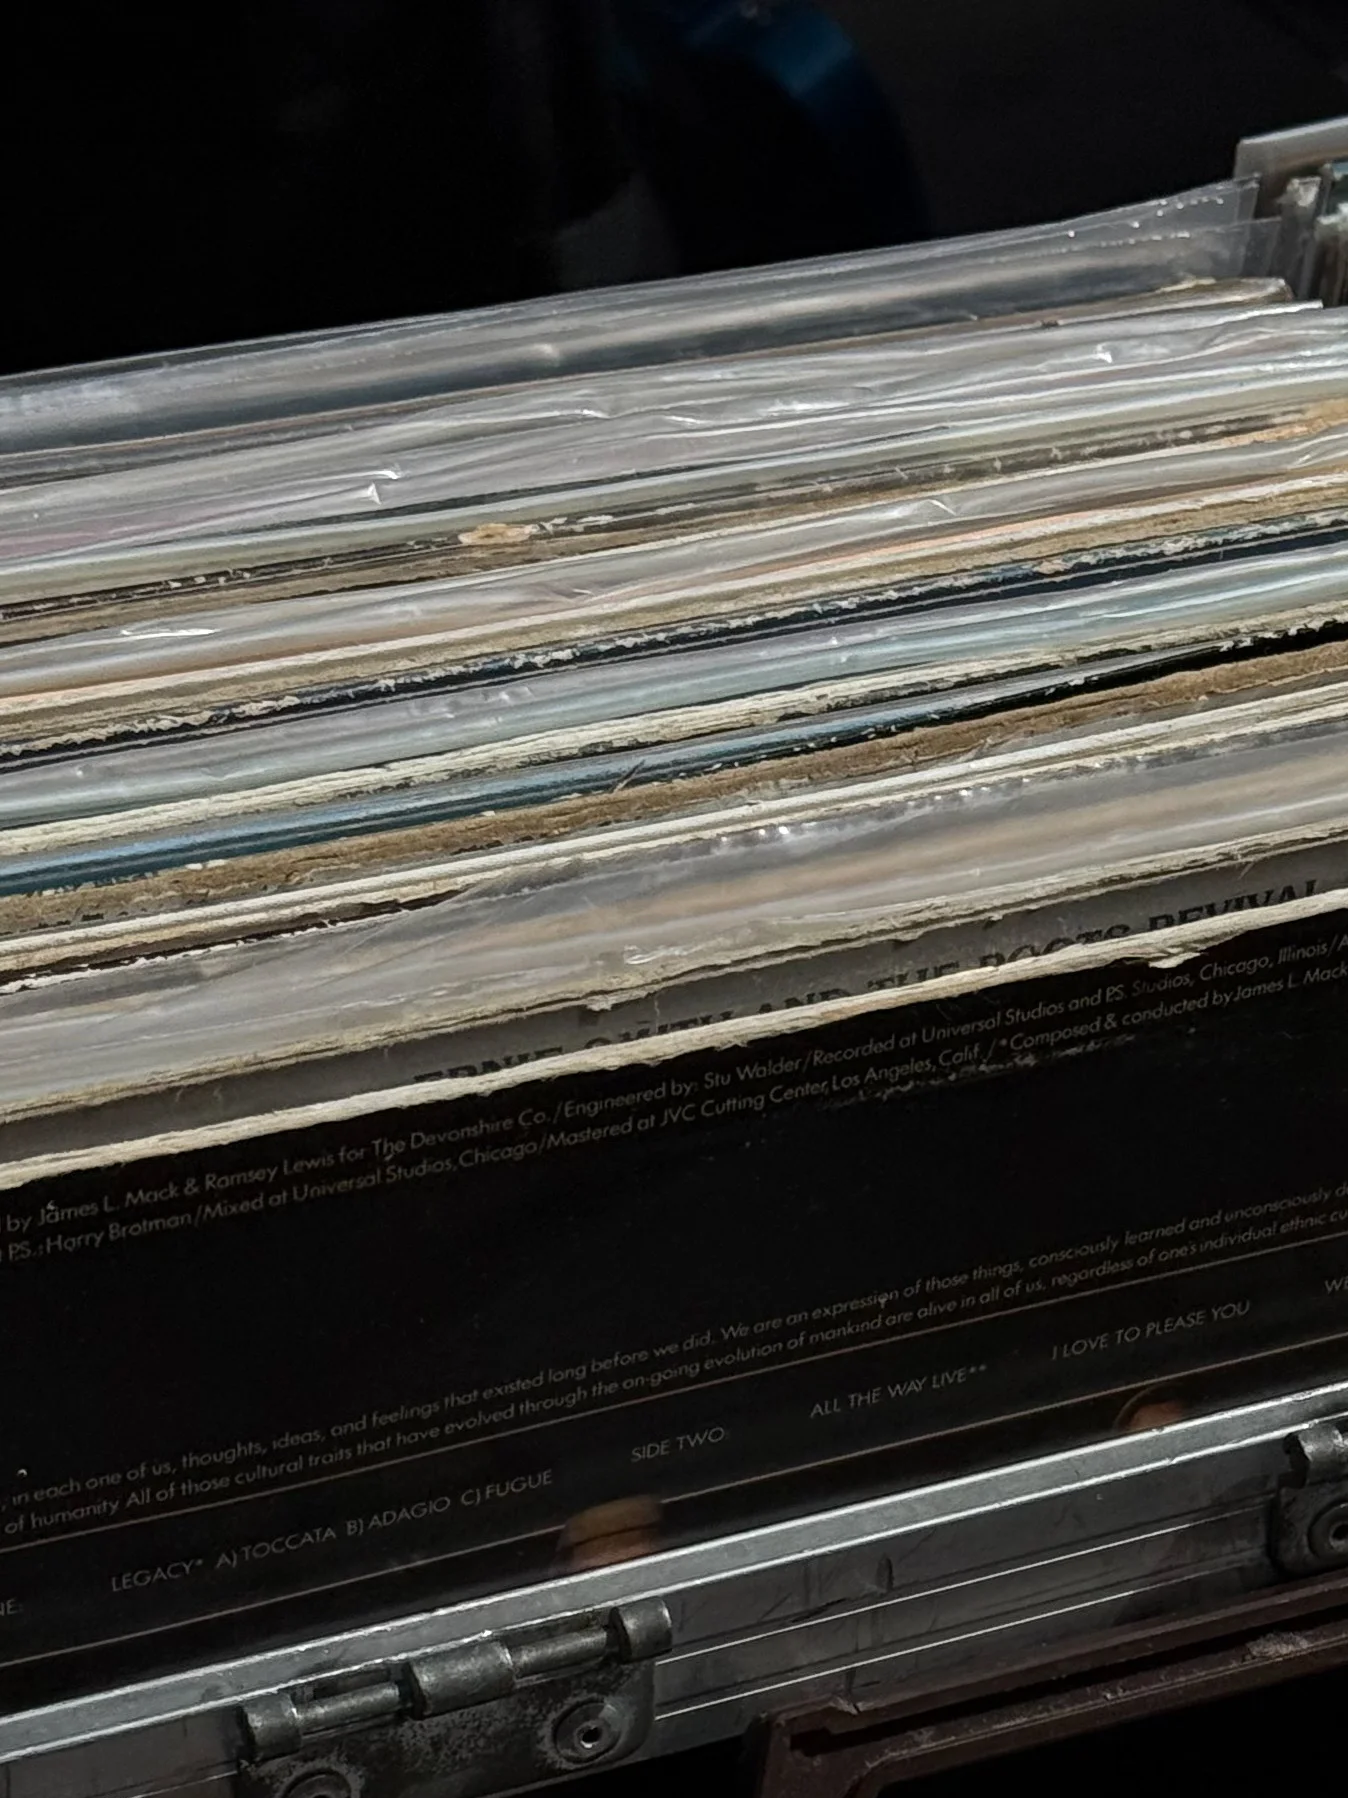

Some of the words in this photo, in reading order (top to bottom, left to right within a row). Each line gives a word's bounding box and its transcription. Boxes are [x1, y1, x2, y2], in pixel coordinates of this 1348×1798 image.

[6, 1215, 31, 1232] by
[38, 1202, 98, 1225] James
[124, 1182, 178, 1207] Mack
[183, 1177, 198, 1195] &
[205, 1166, 277, 1190] Ramsey
[283, 1154, 334, 1175] Lewis
[337, 1145, 364, 1162] for
[410, 1118, 513, 1149] Devonshire
[704, 1071, 730, 1089] Stu
[898, 1031, 917, 1048] at
[921, 1011, 1001, 1042] Universal
[1005, 1001, 1064, 1025] Studios
[1067, 988, 1101, 1010] and
[46, 1231, 104, 1253] Harry
[268, 1189, 287, 1206] at
[292, 1167, 381, 1200] Universal
[637, 1114, 655, 1130] at
[660, 1103, 695, 1126] JVC
[700, 1094, 764, 1116] Cutting
[831, 1074, 860, 1090] Los
[1103, 1013, 1116, 1029] &
[1121, 991, 1208, 1025] conducted
[1212, 990, 1232, 1004] by
[1233, 980, 1283, 1001] James
[1062, 1332, 1108, 1357] LOVE
[1116, 1326, 1140, 1343] TO
[1145, 1310, 1204, 1337] PLEASE
[1211, 1300, 1249, 1320] YOU
[810, 1398, 840, 1417] ALL
[848, 1387, 880, 1407] THE
[887, 1377, 925, 1397] WAY
[631, 1439, 668, 1461] SIDE
[215, 1550, 237, 1568] A)
[241, 1527, 336, 1560] TOCCATA
[346, 1518, 363, 1535] B)
[368, 1496, 450, 1529] ADAGIO
[460, 1488, 480, 1505] C)
[485, 1469, 551, 1498] FUGUE
